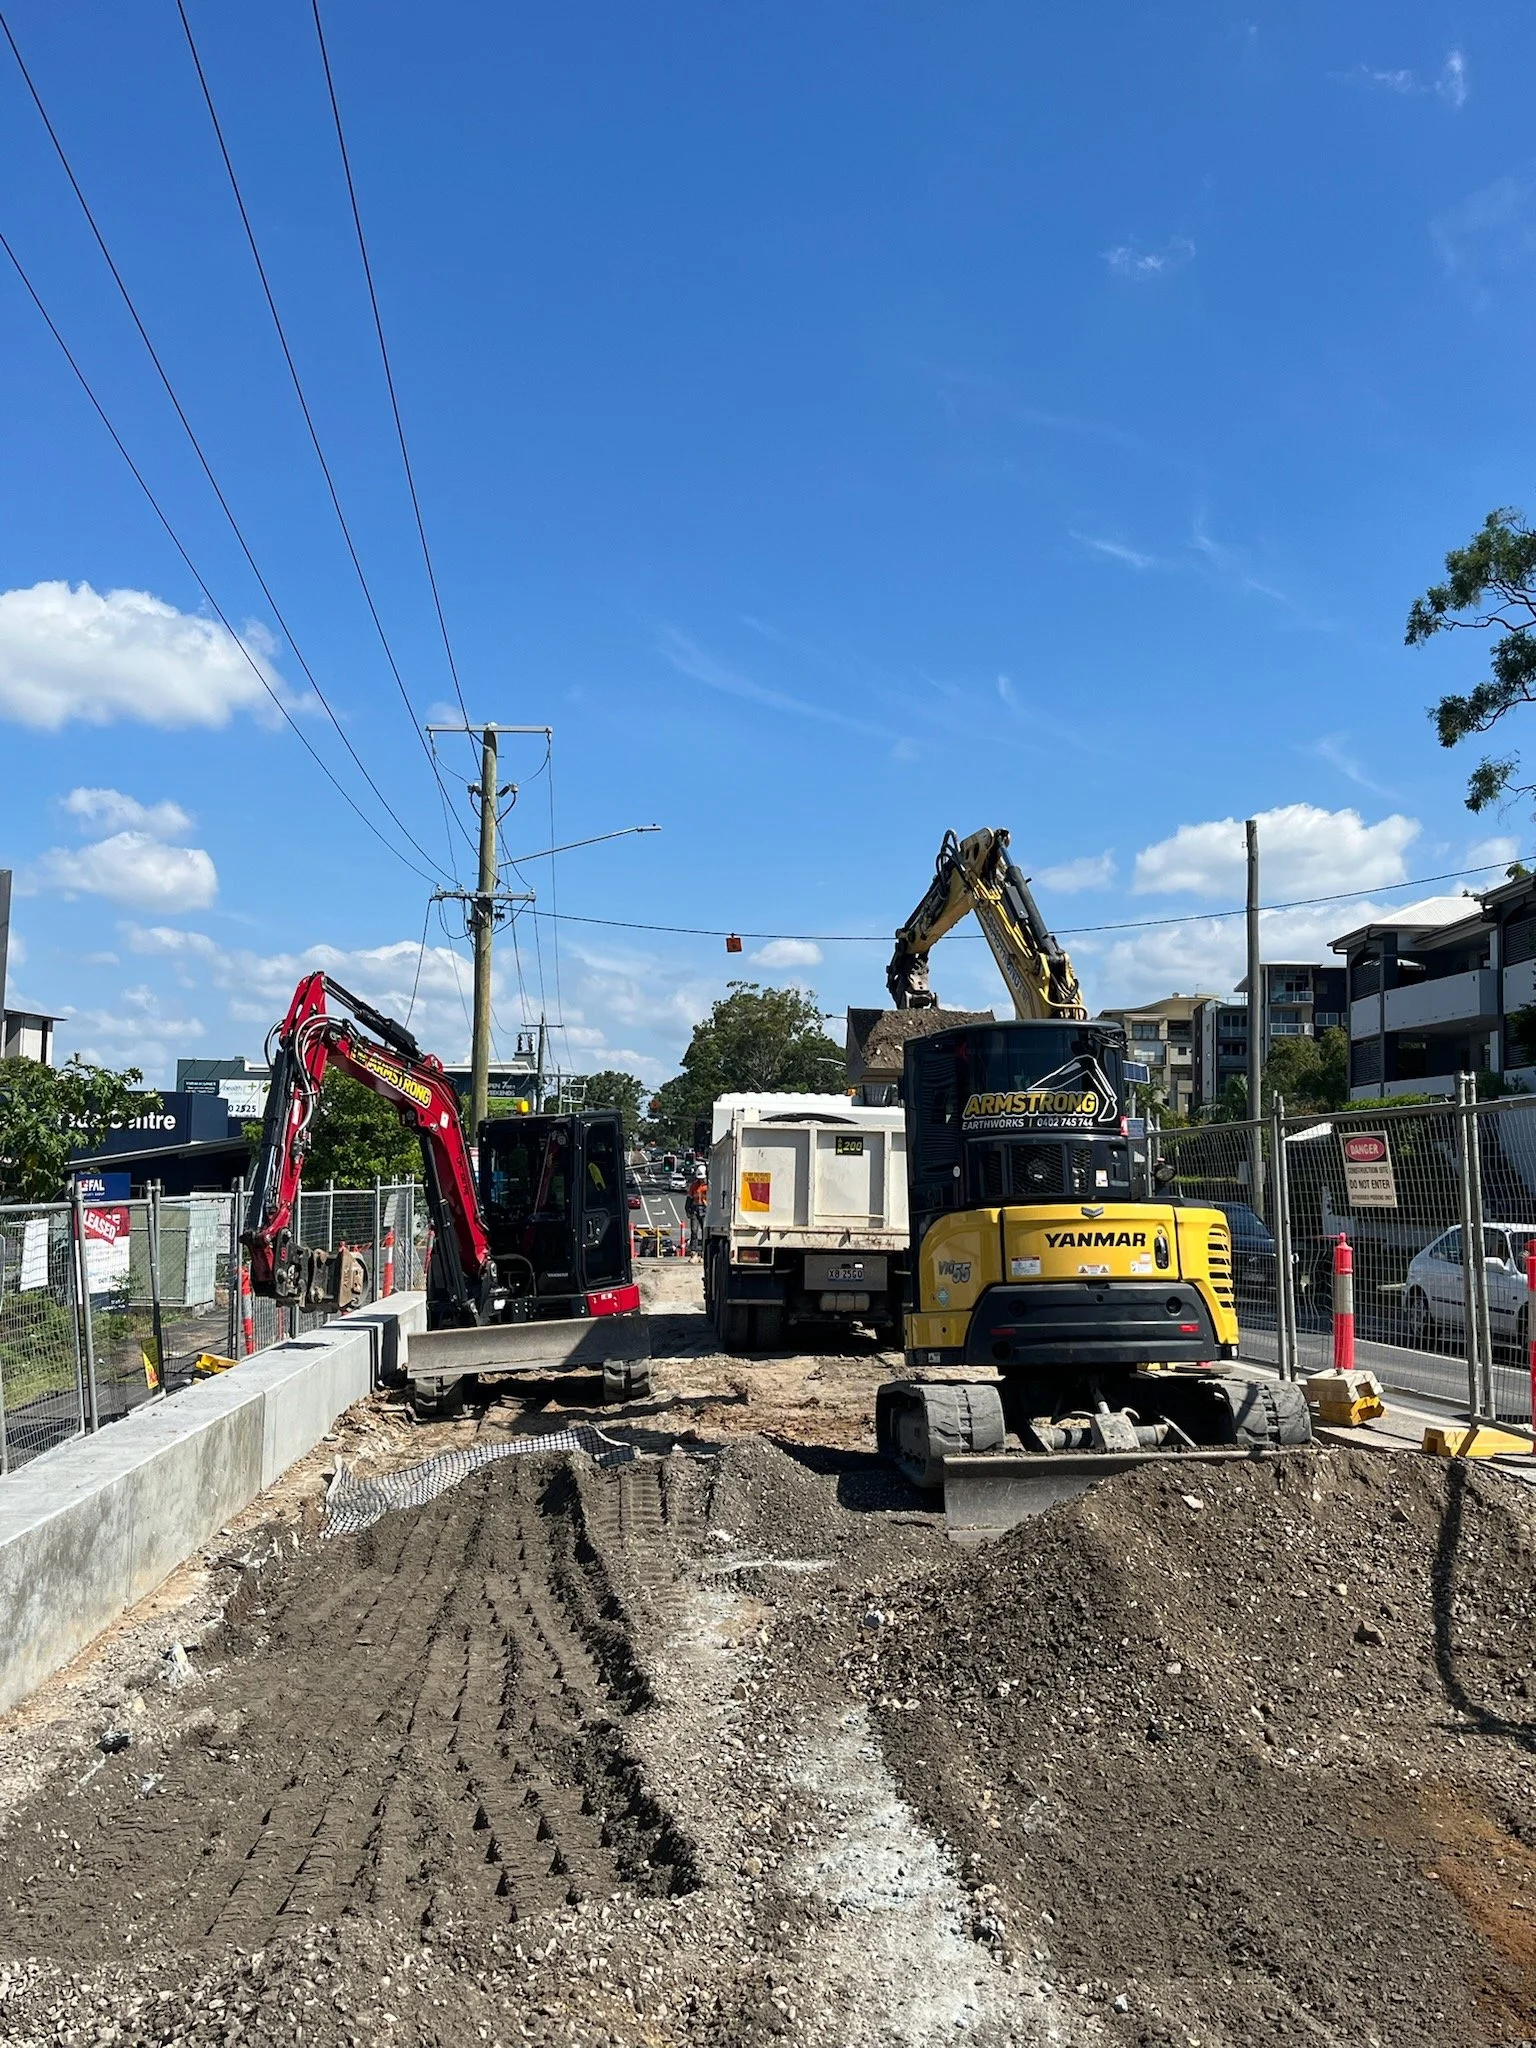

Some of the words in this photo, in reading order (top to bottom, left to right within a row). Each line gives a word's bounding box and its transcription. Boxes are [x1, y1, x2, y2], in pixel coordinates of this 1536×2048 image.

[367, 1055, 431, 1107] ARMSTRONG
[235, 1104, 257, 1113] 2525
[963, 1092, 1098, 1119] ARMSTRONG
[961, 1118, 1025, 1131] EARTHWORKS
[1036, 1118, 1059, 1127] 0402
[1061, 1117, 1077, 1127] 745
[1077, 1117, 1094, 1127] 744
[1349, 1143, 1379, 1155] DANGER
[1349, 1180, 1358, 1190] DO
[1358, 1180, 1370, 1190] NOT
[1371, 1179, 1391, 1190] ENTER
[84, 1209, 117, 1241] LEASED
[1044, 1232, 1146, 1248] YANMAR
